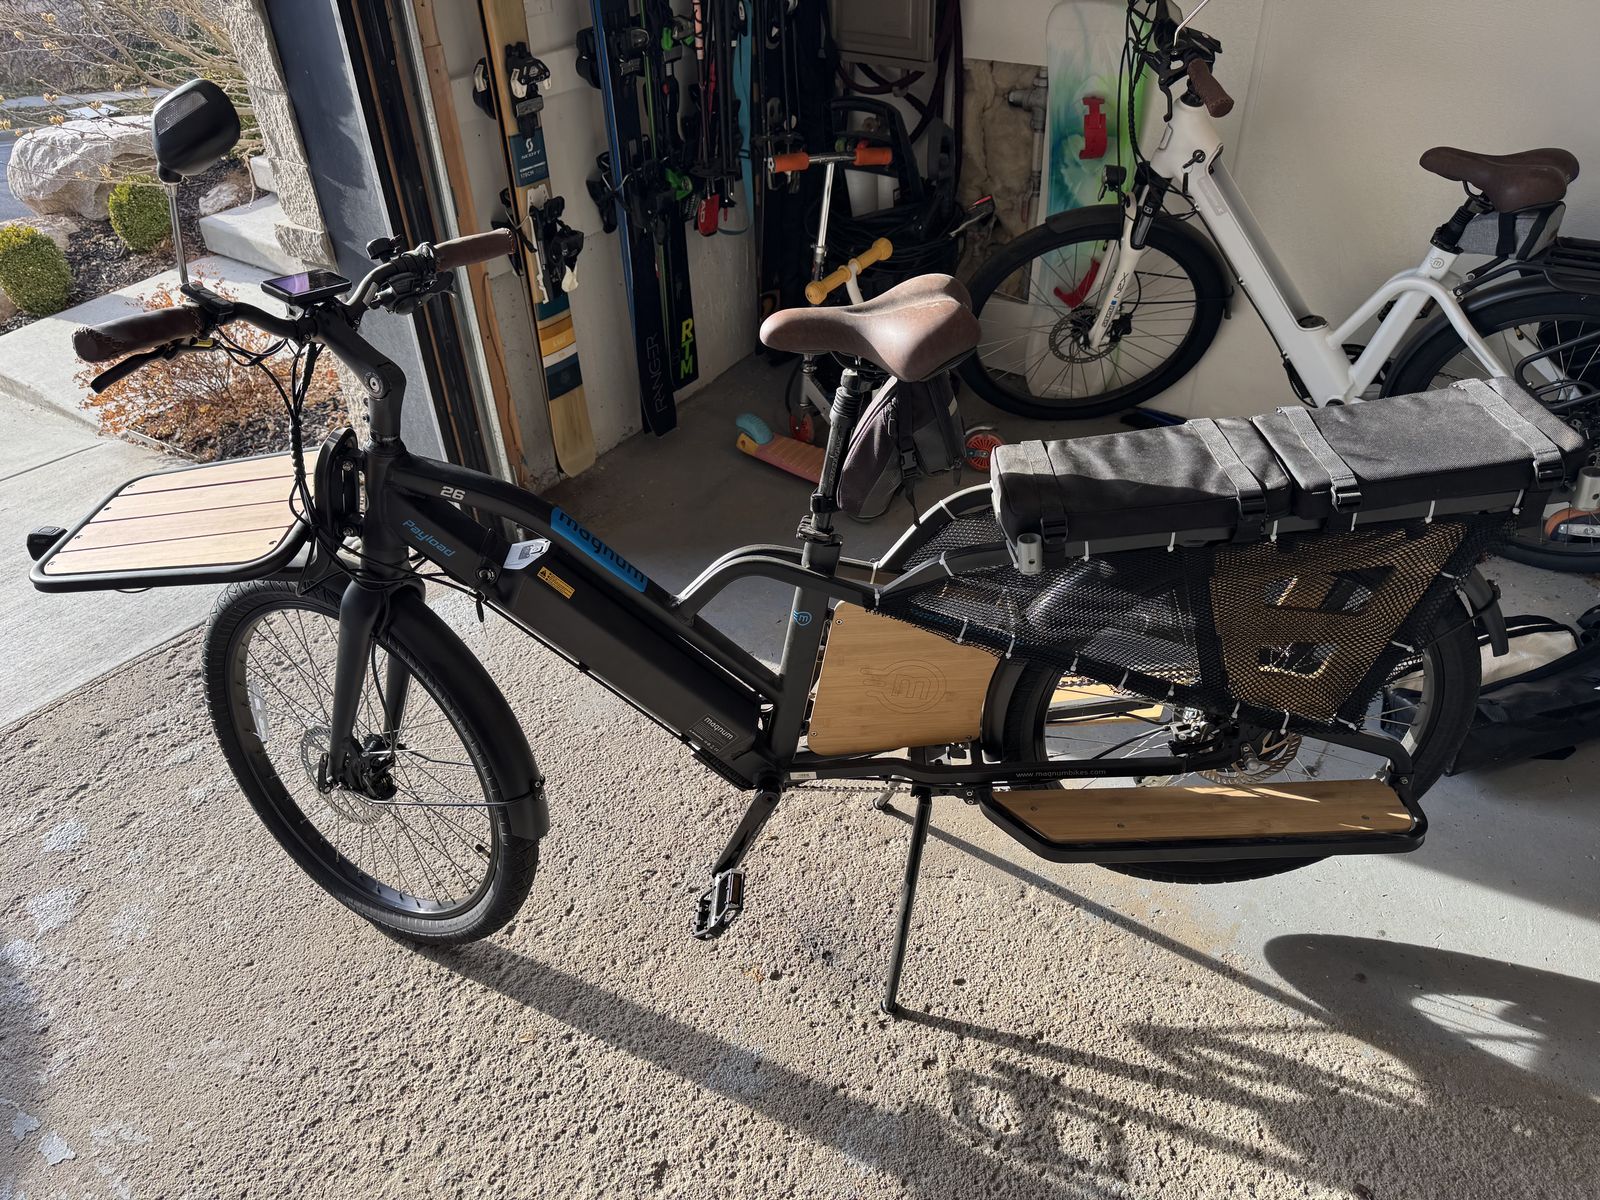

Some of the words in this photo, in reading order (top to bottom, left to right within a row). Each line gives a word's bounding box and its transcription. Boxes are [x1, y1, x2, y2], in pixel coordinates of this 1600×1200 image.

[681, 318, 694, 380] RTM
[440, 486, 466, 501] 26
[402, 519, 456, 557] Payload
[559, 511, 645, 584] magnum
[704, 717, 734, 740] magnum
[1015, 769, 1106, 778] www.magnumbikes.com
